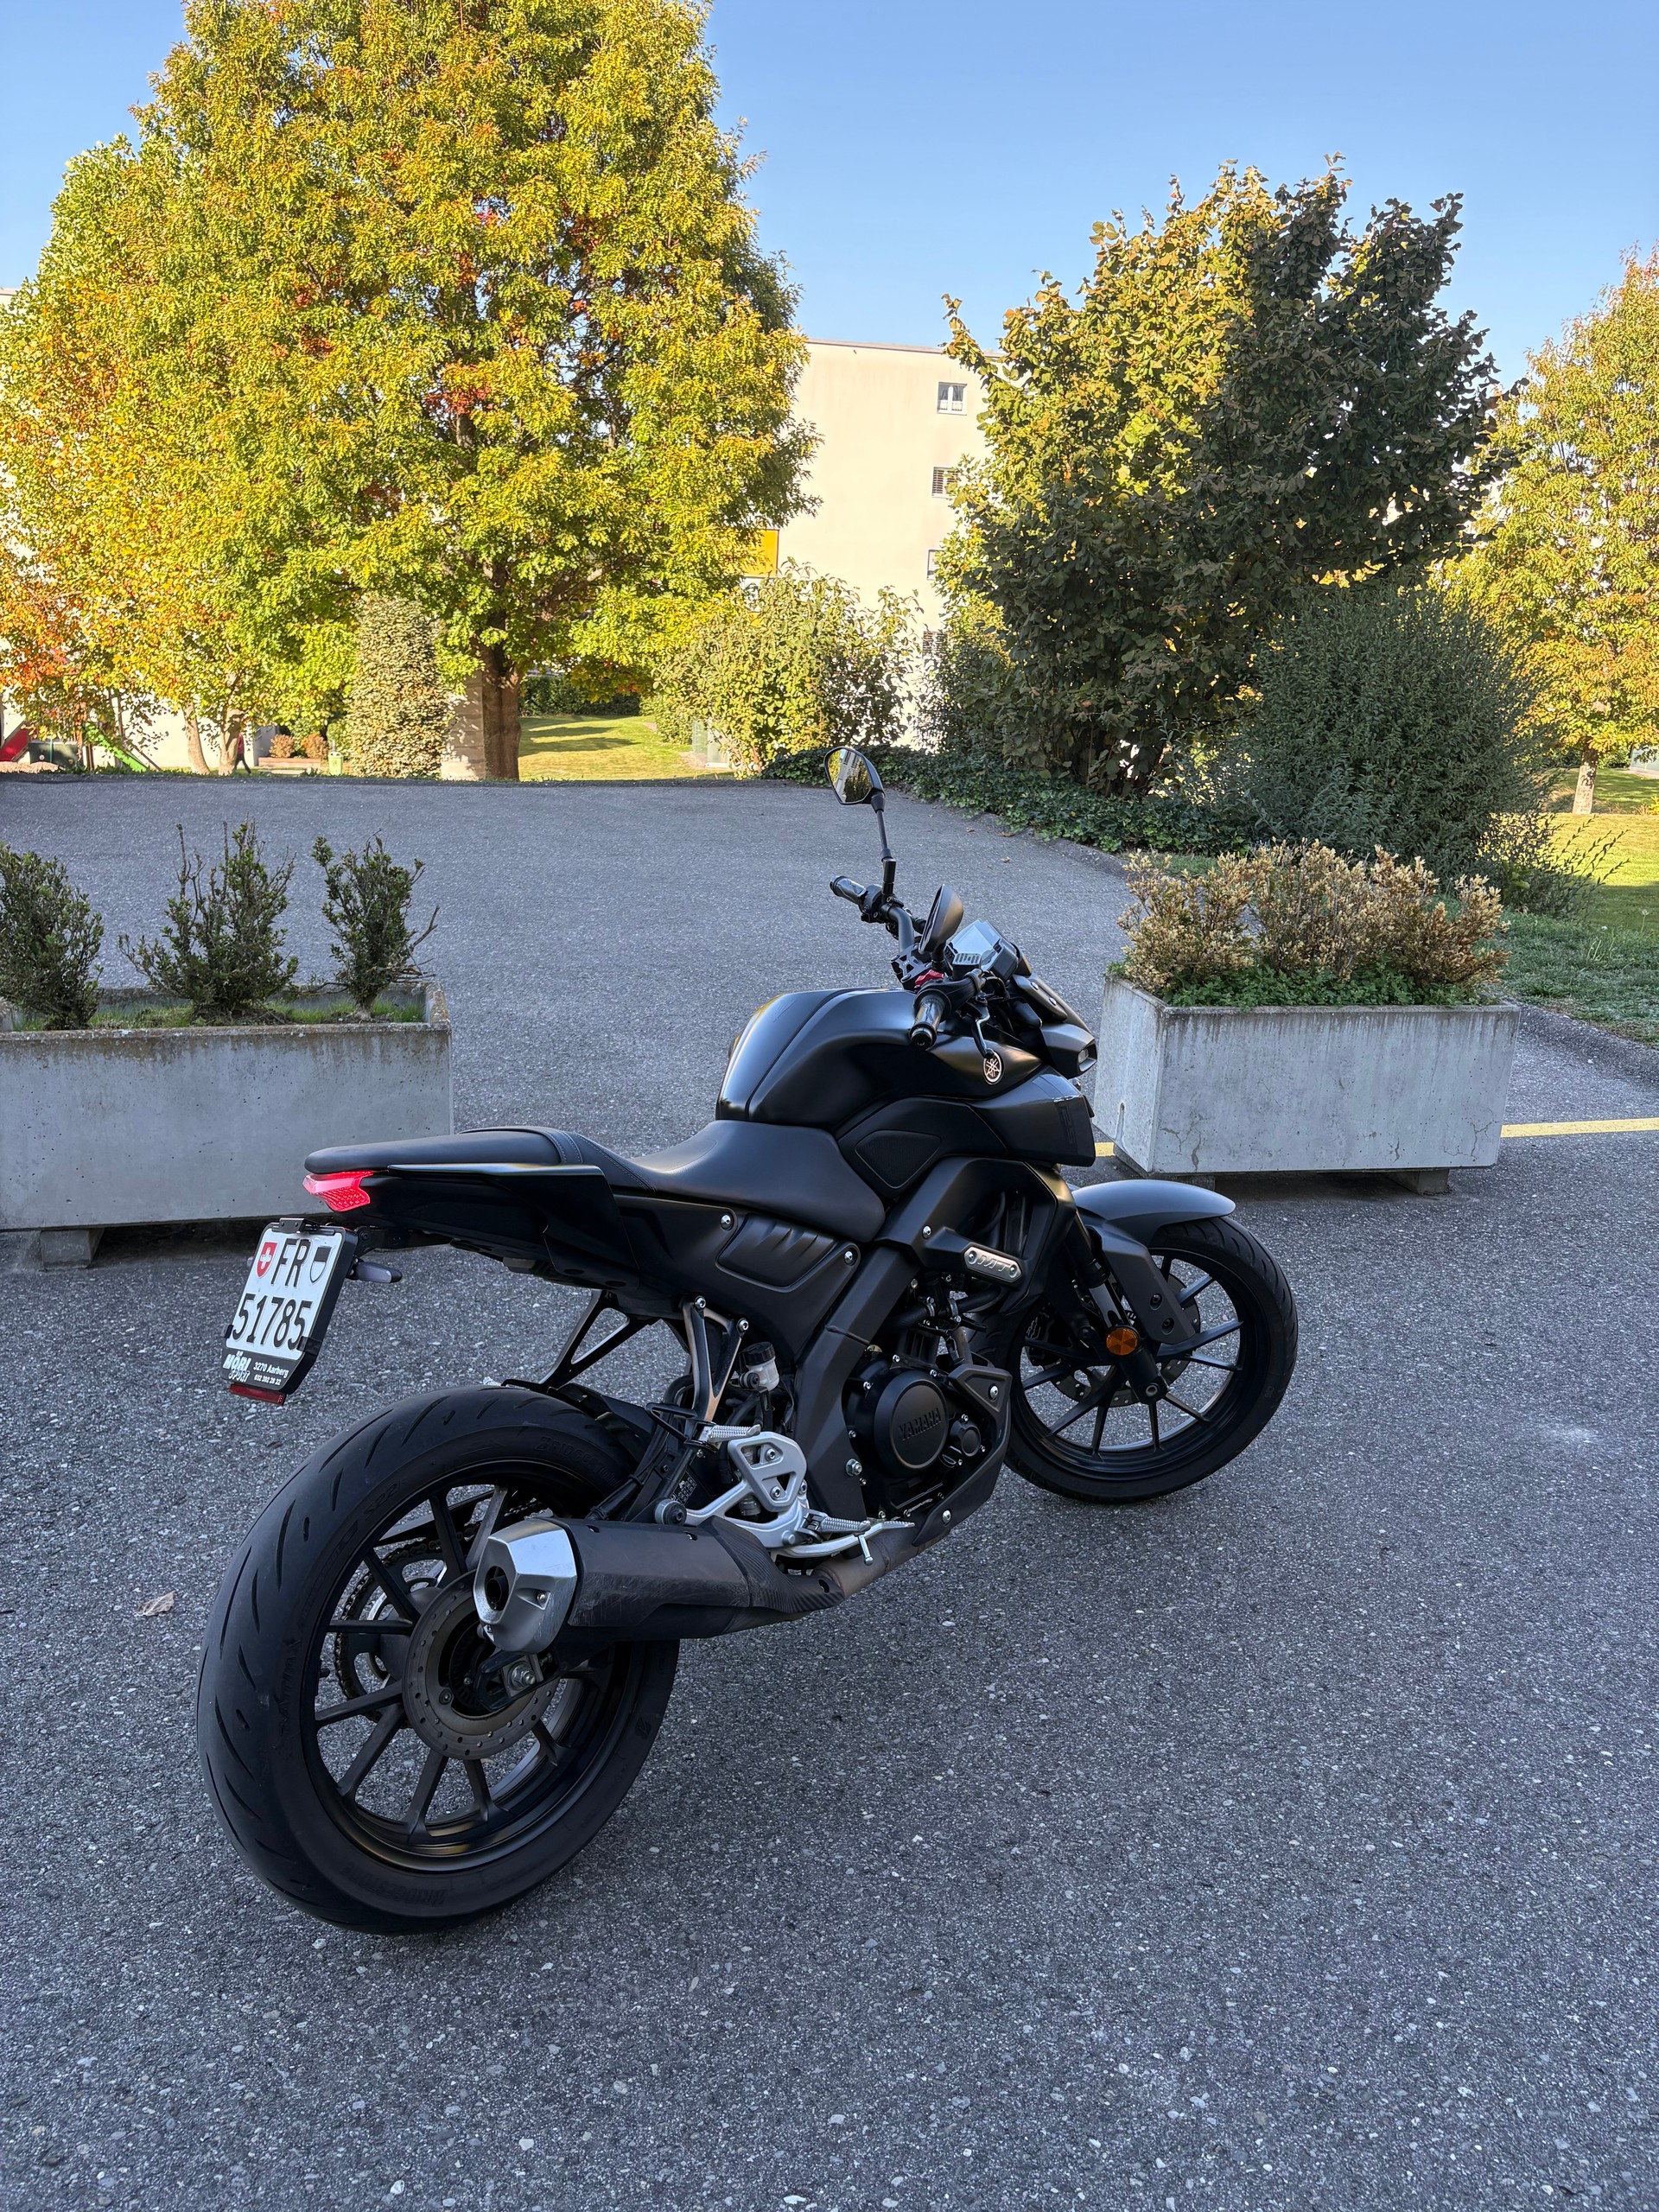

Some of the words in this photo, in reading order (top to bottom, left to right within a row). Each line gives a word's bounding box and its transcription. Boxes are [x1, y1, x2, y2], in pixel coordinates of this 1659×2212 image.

[271, 1238, 311, 1287] FR
[977, 1255, 1011, 1272] MT
[232, 1293, 314, 1351] 51785
[228, 1369, 251, 1382] SPORT
[253, 1362, 268, 1372] 3270
[266, 1364, 289, 1379] Aarberg
[899, 1408, 942, 1441] YAMAHA
